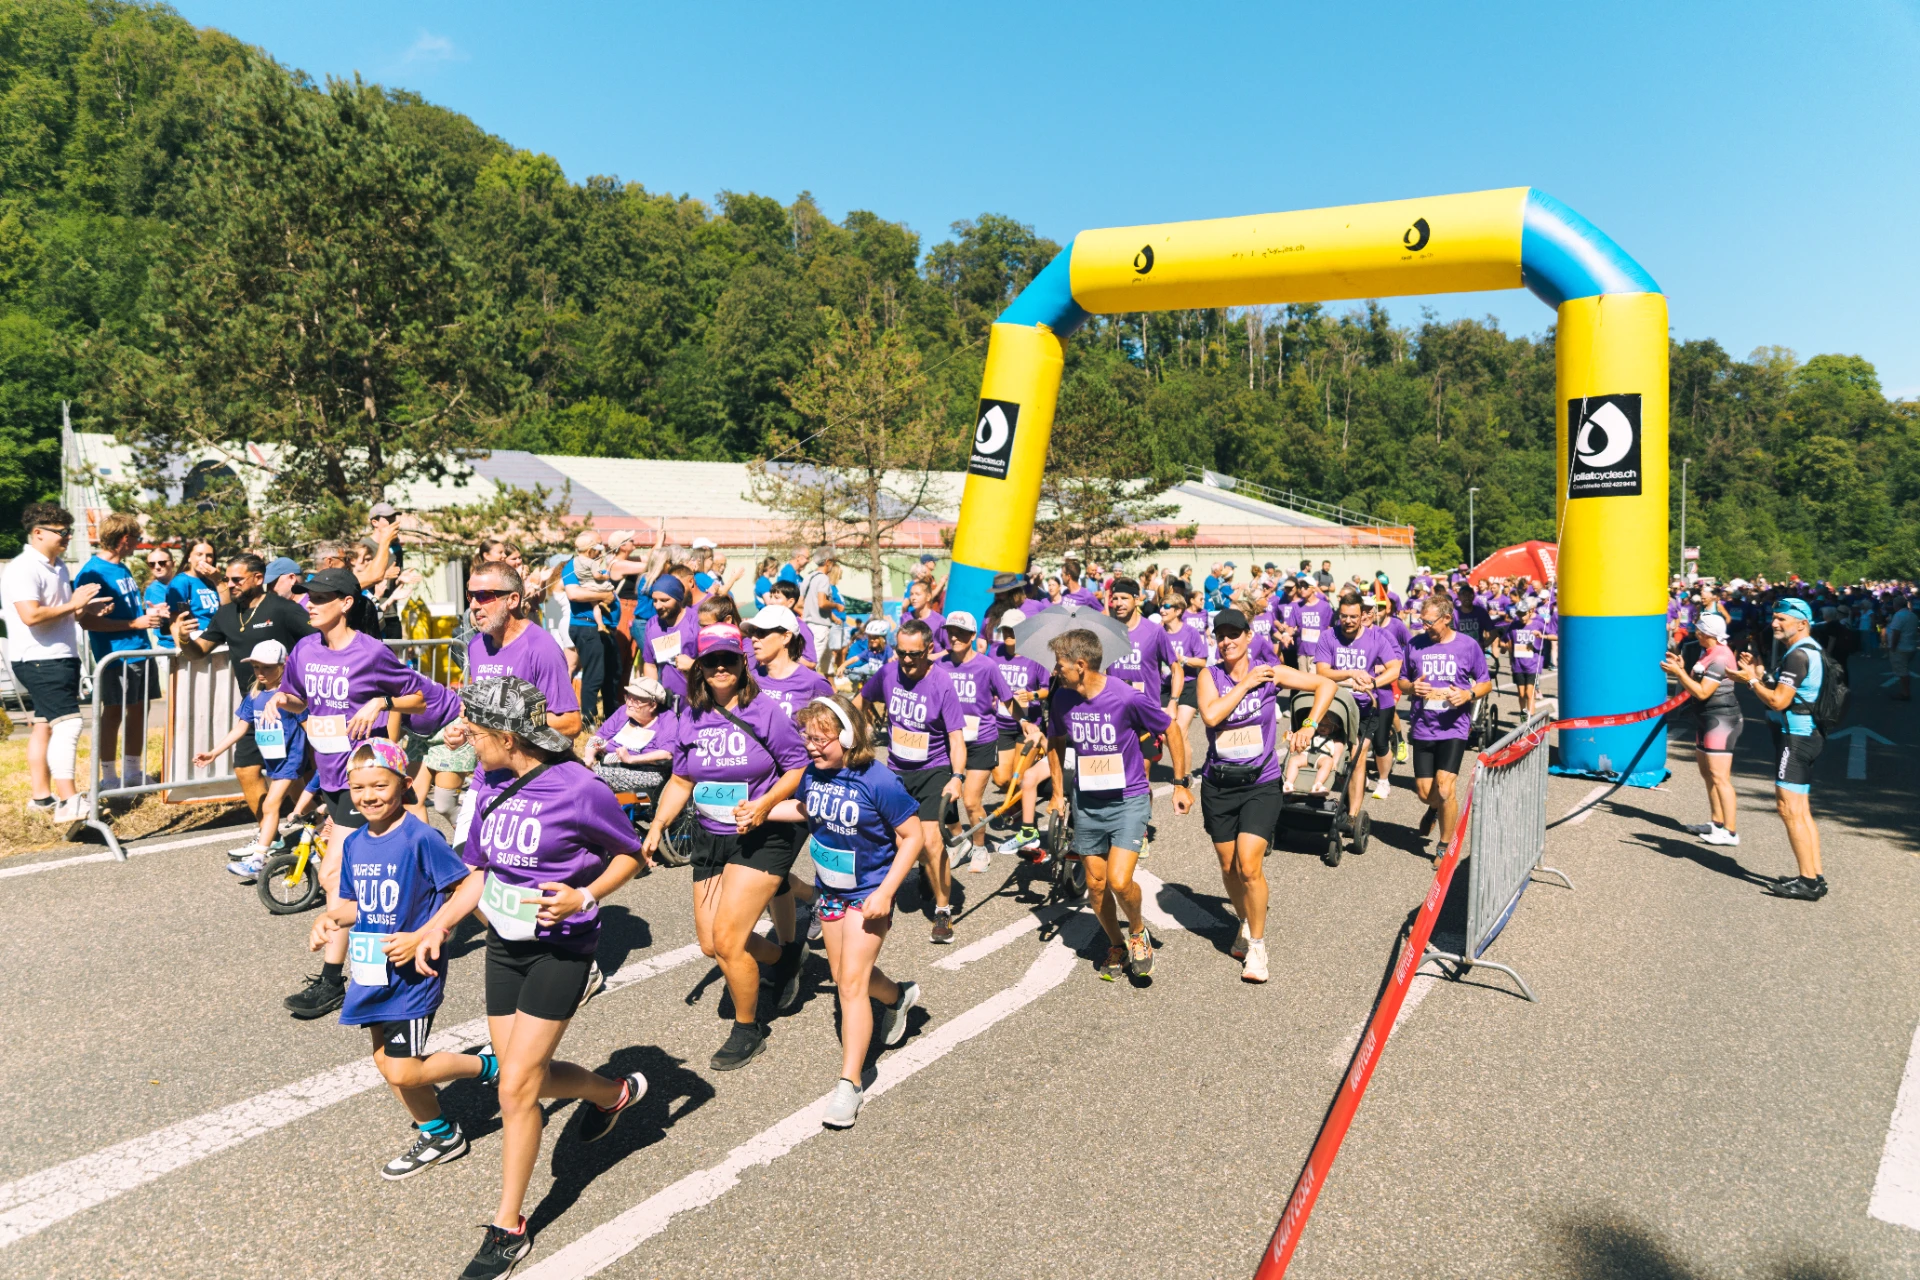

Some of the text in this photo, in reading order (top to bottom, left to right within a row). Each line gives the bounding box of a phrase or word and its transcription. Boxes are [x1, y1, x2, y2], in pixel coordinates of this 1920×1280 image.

[1302, 616, 1320, 624] DUO
[1460, 622, 1479, 631] DUO
[1254, 624, 1272, 633] DUO
[1516, 633, 1536, 642] DUO
[305, 662, 339, 674] COURSE
[998, 664, 1020, 672] COURSE
[1336, 654, 1367, 669] DUO
[1422, 660, 1456, 676] DUO
[478, 664, 504, 674] COURSE
[304, 674, 350, 700] DUO
[892, 687, 918, 701] COURSE
[325, 699, 350, 708] SUISSE
[889, 696, 927, 722] DUO
[904, 719, 926, 729] SUISSE
[1071, 712, 1100, 722] COURSE
[900, 732, 922, 748] 111
[1072, 722, 1116, 744] DUO
[1229, 730, 1251, 745] 111
[694, 732, 746, 757] DUO
[1093, 744, 1118, 752] SUISSE
[716, 756, 748, 767] SUISSE
[1090, 758, 1110, 772] 111
[1778, 746, 1790, 780] ORBEA
[702, 786, 735, 800] 261
[806, 791, 860, 827] DUO
[480, 812, 542, 854] DUO
[826, 822, 858, 836] SUISSE
[496, 852, 538, 867] SUISSE
[813, 844, 839, 866] 261
[490, 880, 522, 915] 50
[367, 914, 396, 926] SUISSE
